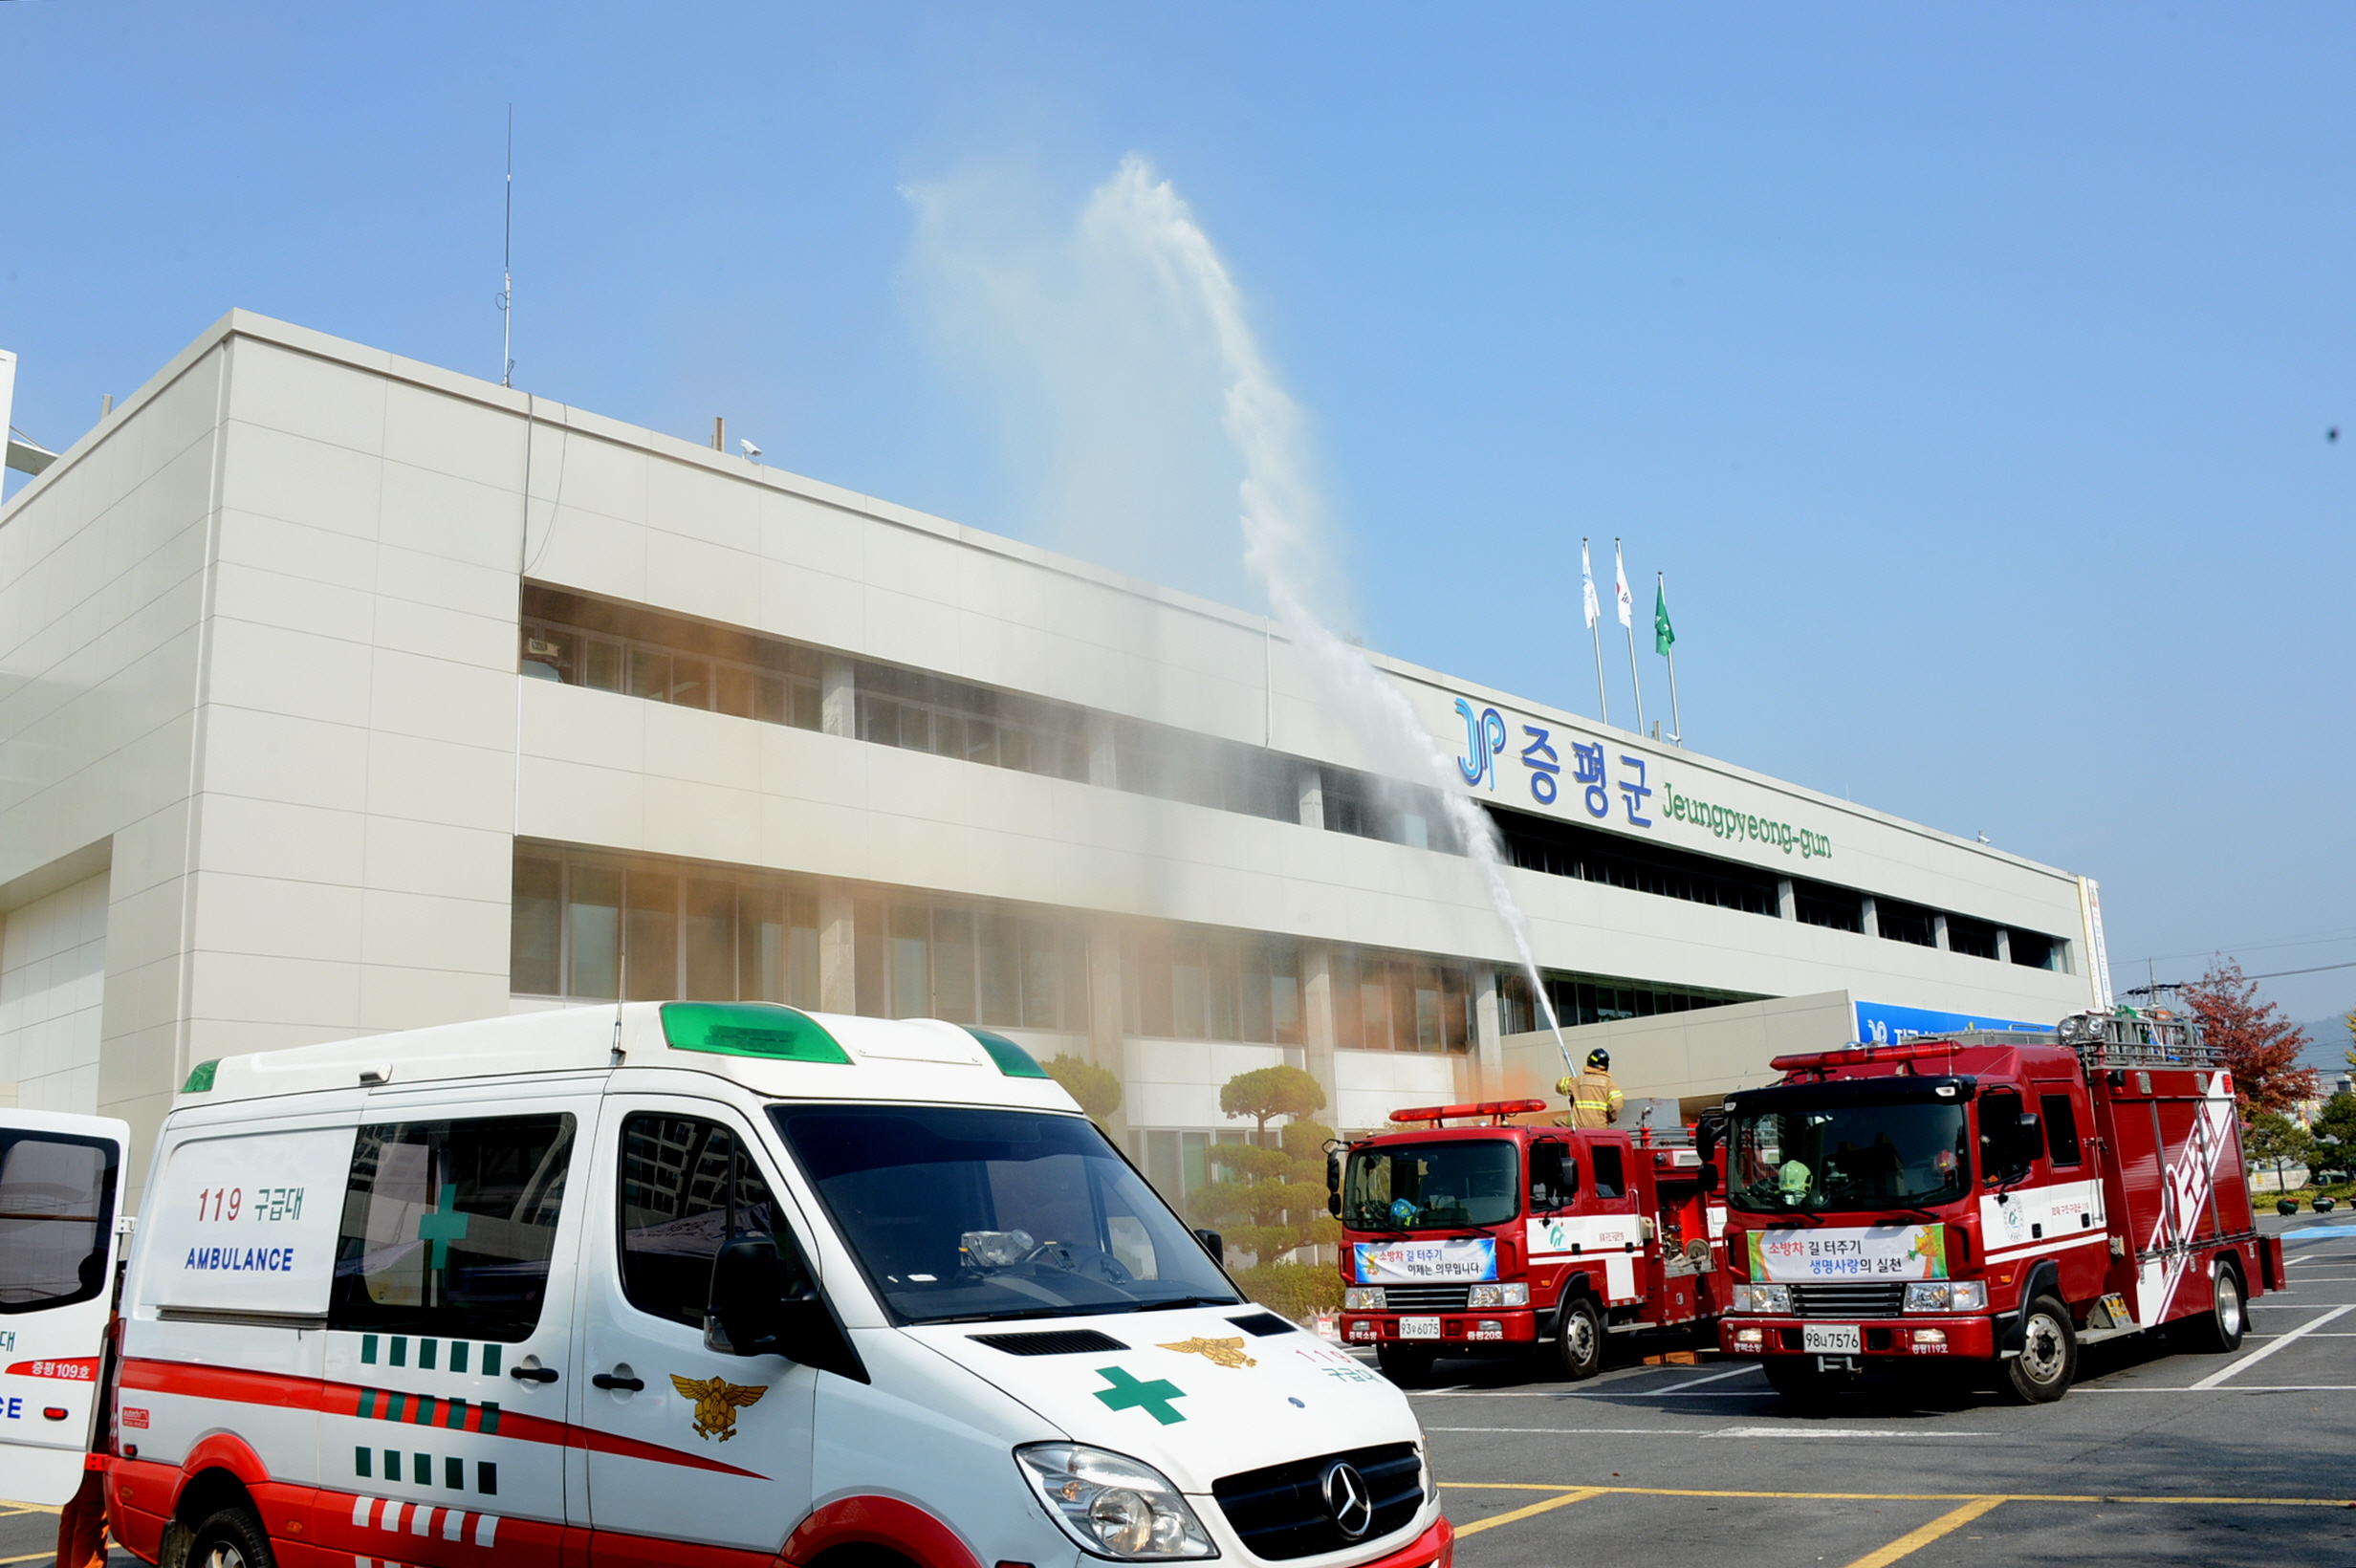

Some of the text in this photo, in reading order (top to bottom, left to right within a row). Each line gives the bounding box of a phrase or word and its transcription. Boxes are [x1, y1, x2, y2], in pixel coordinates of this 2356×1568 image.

[1521, 724, 1652, 828] 증평군
[1662, 782, 1833, 859] Jeungpyeong-gun
[199, 1187, 304, 1221] 119 구급대
[1769, 1240, 1862, 1255] 소방차 길 터주기
[185, 1248, 294, 1272] AMBULANCE
[1379, 1249, 1443, 1262] 소방차 길 터주기
[1407, 1262, 1483, 1276] 이제는 의무입니다.
[1810, 1257, 1902, 1274] 생명사랑의 실천
[1467, 1331, 1503, 1340] 증평20호
[1296, 1350, 1352, 1363] 119
[1912, 1343, 1949, 1355] 증평119호
